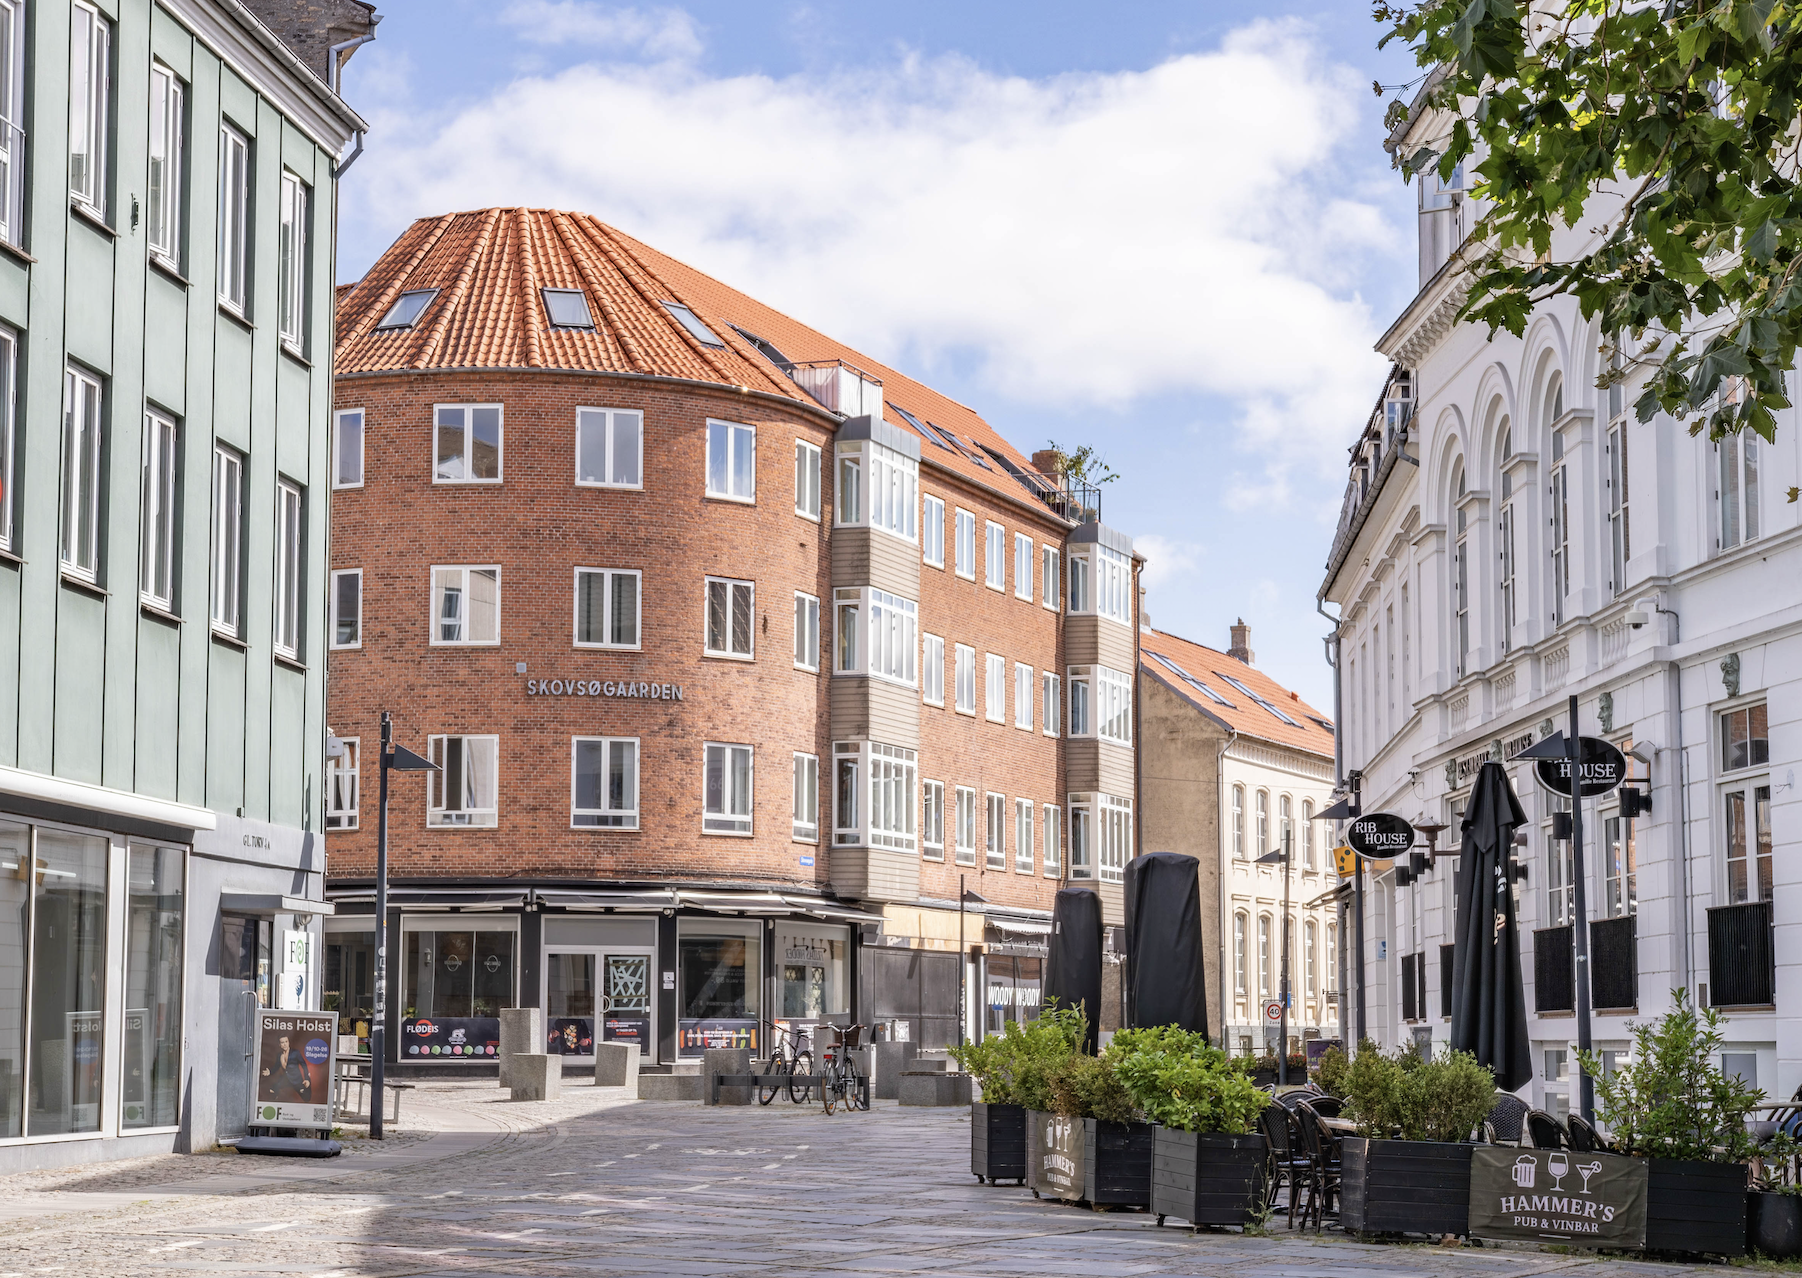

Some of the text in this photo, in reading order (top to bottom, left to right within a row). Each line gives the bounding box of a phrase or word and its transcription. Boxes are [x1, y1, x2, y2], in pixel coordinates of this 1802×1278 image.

[527, 679, 683, 700] SKOVSØGAARDEN
[1355, 822, 1377, 834] RIB
[1365, 833, 1407, 845] HOUSE
[988, 986, 1041, 1007] WOODY WOODY
[264, 1018, 331, 1032] Silas Holst
[406, 1025, 439, 1033] FLØDEIS
[1043, 1154, 1075, 1177] HAMMER'S
[1500, 1195, 1615, 1223] HAMMER'S
[1513, 1216, 1599, 1233] PUB & VINBAR
